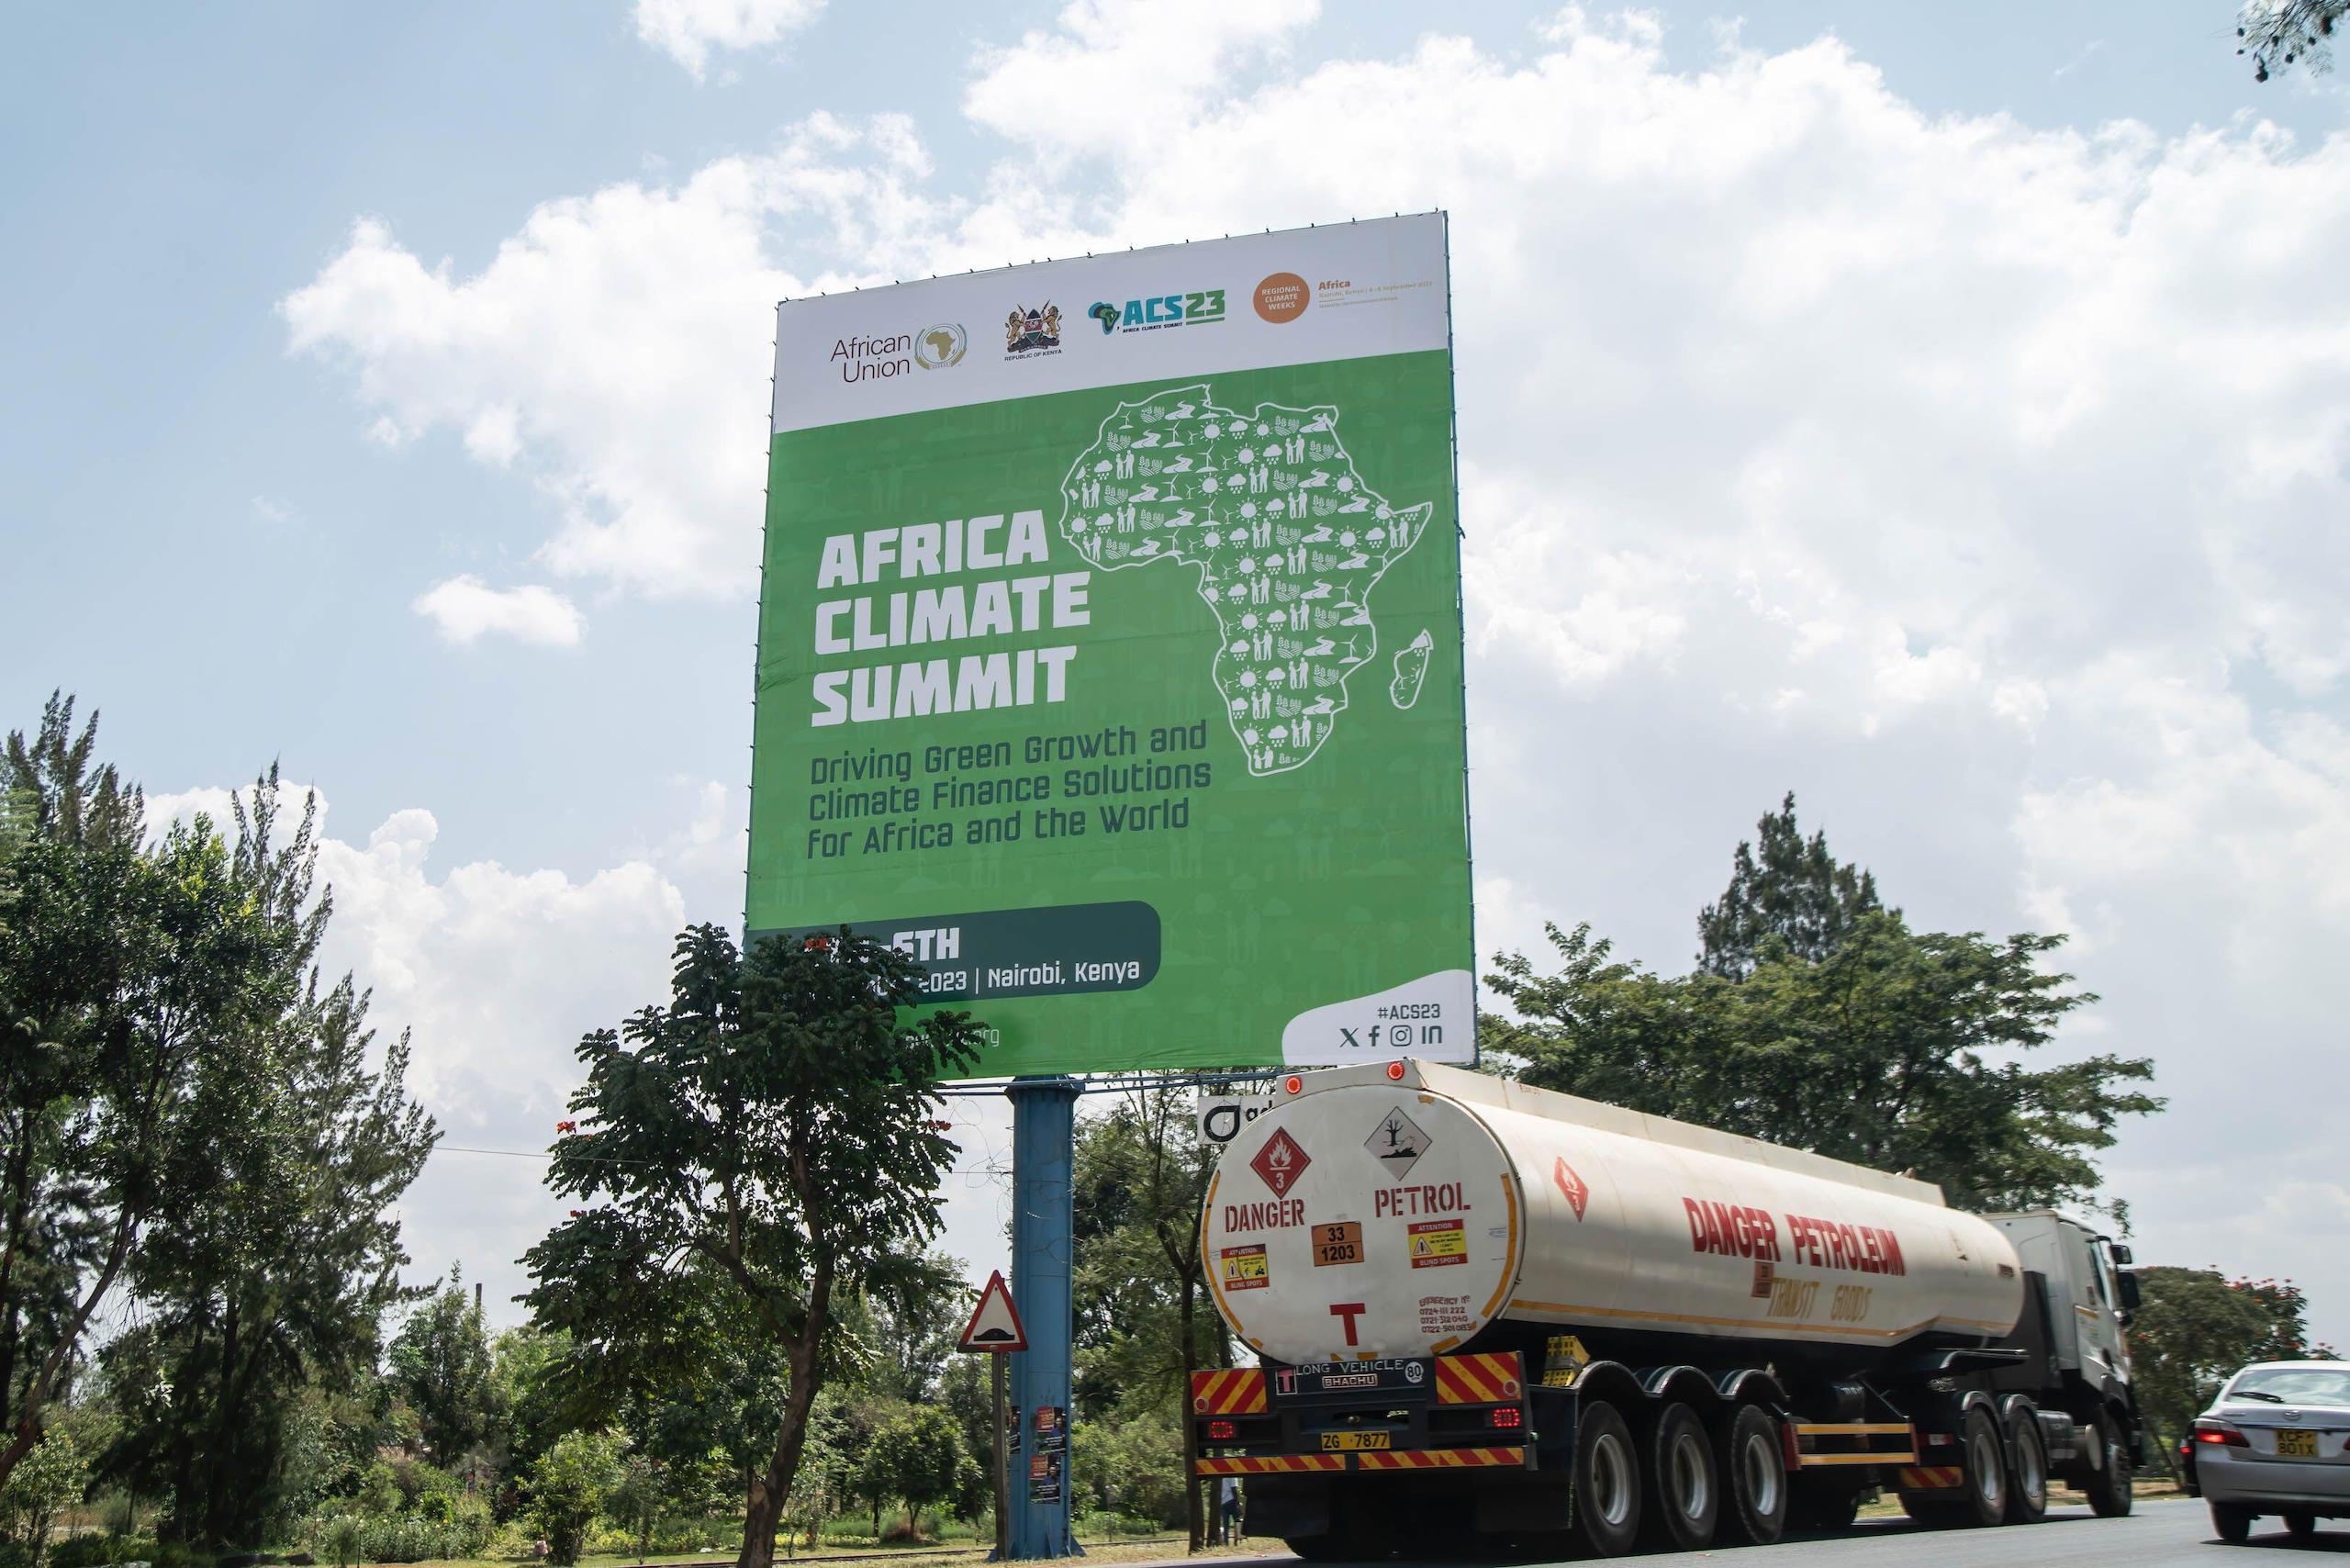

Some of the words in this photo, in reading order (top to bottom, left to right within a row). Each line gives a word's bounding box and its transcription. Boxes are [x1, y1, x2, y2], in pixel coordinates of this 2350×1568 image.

[1262, 286, 1301, 296] REGIONAL
[1317, 279, 1351, 290] Africa
[1123, 289, 1225, 326] ACS23
[1265, 294, 1298, 303] CLIMATE
[1268, 301, 1296, 310] WEEKS
[830, 334, 911, 363] African
[1004, 353, 1033, 362] REPUBLIC
[1042, 349, 1062, 357] KENYA
[843, 357, 910, 383] Union
[817, 510, 1049, 589] AFRICA
[814, 571, 1091, 655] CLIMATE
[811, 645, 1077, 728] SUMMIT
[811, 747, 912, 785] Driving
[924, 741, 1011, 773] Green
[1024, 724, 1136, 764] Growth
[1150, 719, 1207, 753] and
[810, 784, 919, 822] Climate
[933, 776, 1050, 810] Finance
[1064, 758, 1211, 798] Solutions
[807, 828, 853, 859] for
[863, 818, 953, 855] Africa
[966, 811, 1021, 845] and
[1035, 807, 1086, 839] the
[1099, 797, 1190, 834] World
[918, 970, 967, 993] 2023
[988, 960, 1067, 990] Nairobi,
[1075, 960, 1140, 984] Kenya
[1378, 1003, 1440, 1020] #ACS23
[1275, 1172, 1285, 1190] 3
[1225, 1199, 1305, 1233] DANGER
[1374, 1182, 1472, 1218] PETROL
[1327, 1226, 1345, 1242] 33
[1418, 1222, 1453, 1232] ATTENTION
[1682, 1196, 1782, 1262] DANGER
[1784, 1213, 1906, 1277] PETROLEUM
[1322, 1244, 1355, 1262] 1203
[1419, 1258, 1438, 1266] BLIND
[1439, 1256, 1460, 1264] SPOTS
[1329, 1303, 1366, 1346] T
[1296, 1363, 1330, 1376] LONG
[1340, 1359, 1404, 1374] VEHICLE
[1407, 1365, 1421, 1378] 80
[1277, 1369, 1293, 1393] T
[1324, 1375, 1375, 1387] BHACHU
[1323, 1435, 1340, 1449] ZG
[1354, 1433, 1388, 1448] 7877
